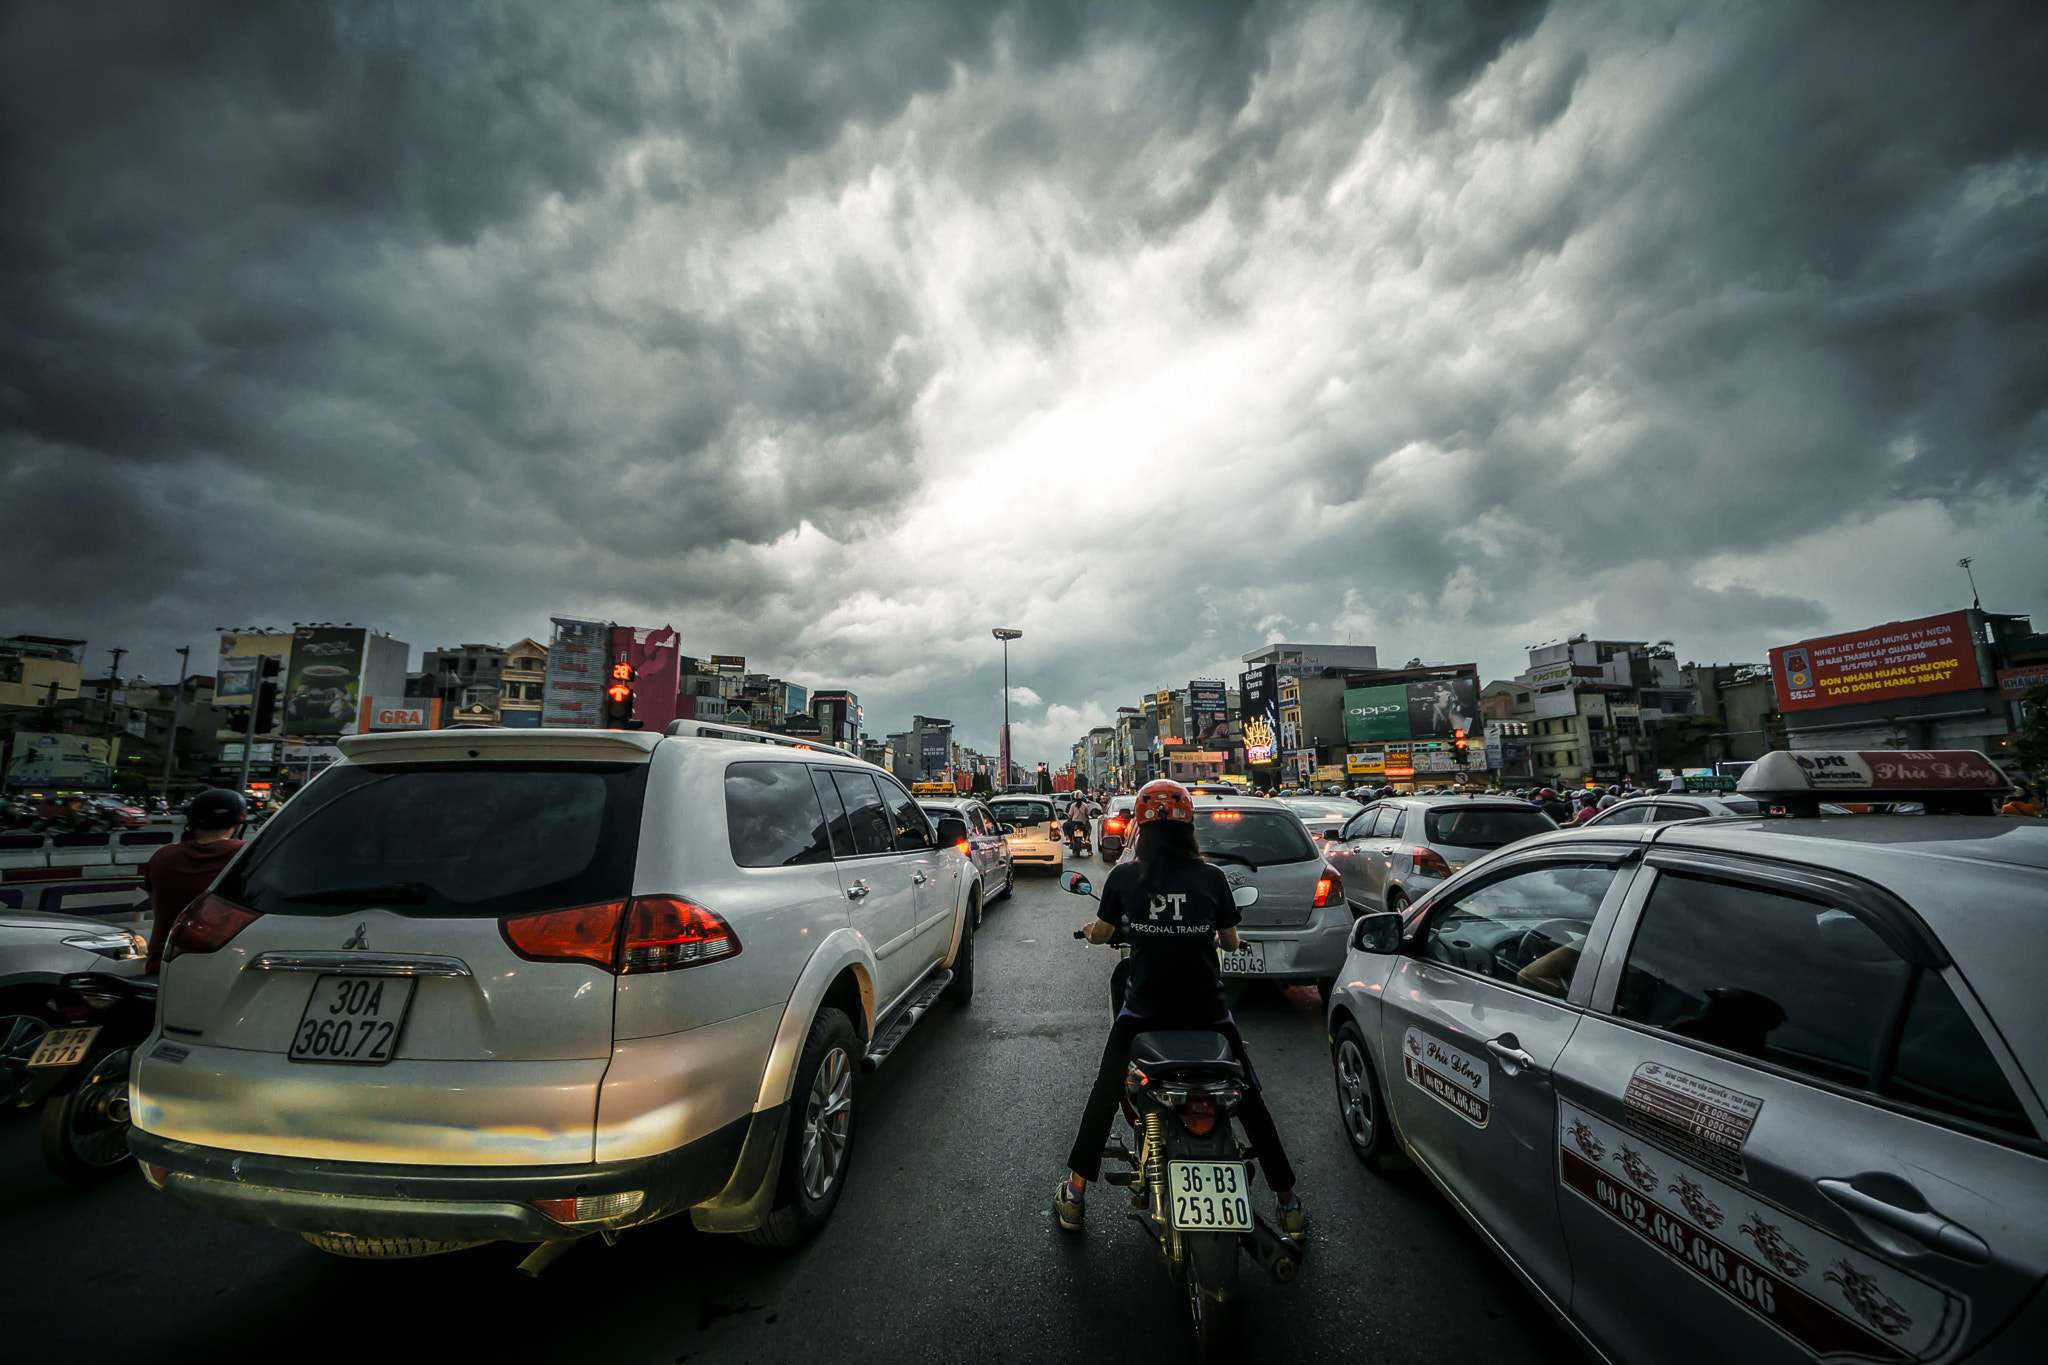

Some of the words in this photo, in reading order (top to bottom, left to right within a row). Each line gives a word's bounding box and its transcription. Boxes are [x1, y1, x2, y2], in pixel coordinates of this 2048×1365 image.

[1884, 652, 1927, 665] 31/5/2016
[1245, 670, 1263, 682] Golden
[1532, 668, 1571, 683] FASTER
[1246, 680, 1263, 690] Crown
[1828, 685, 1850, 696] LAO
[1790, 690, 1803, 701] 55
[379, 709, 421, 724] GRA
[1814, 755, 1849, 769] ptt
[1809, 771, 1862, 779] Lubricants
[1148, 893, 1187, 920] PT
[1131, 922, 1175, 934] PERSONAL
[1176, 924, 1210, 934] TRAINER
[1223, 957, 1264, 972] 660.43
[330, 980, 384, 1016] 30A
[296, 1018, 395, 1058] 360.72
[1695, 1114, 1725, 1132] 10.000
[1694, 1126, 1721, 1143] 8.000
[1180, 1165, 1237, 1194] 36-B3
[1176, 1196, 1248, 1226] 253.60
[1596, 1178, 1618, 1211] (04)
[1620, 1189, 1777, 1315] 62.66.66.66
